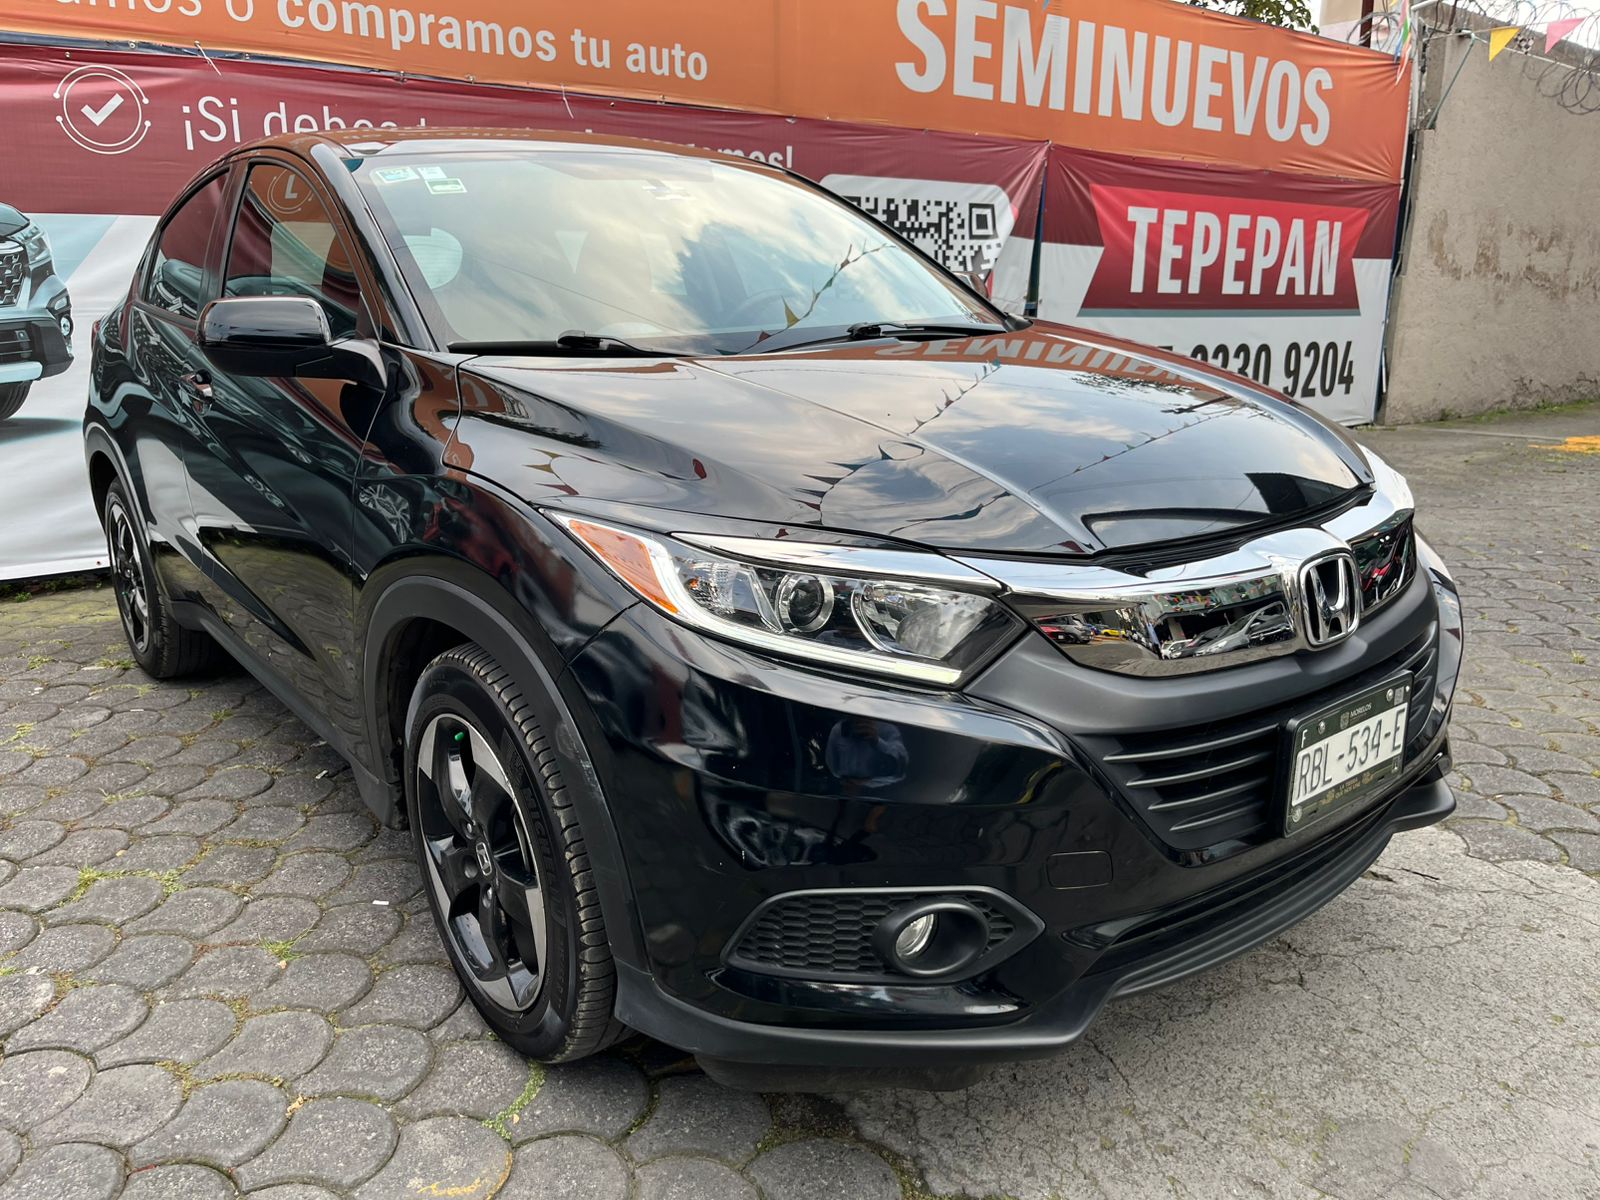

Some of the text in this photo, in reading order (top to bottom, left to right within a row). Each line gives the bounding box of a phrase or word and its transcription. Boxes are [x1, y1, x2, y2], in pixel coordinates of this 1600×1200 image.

[277, 0, 557, 63] compramos
[570, 28, 611, 69] tu
[625, 41, 708, 81] auto
[895, 0, 1334, 146] SEMINUEVOS
[182, 96, 398, 151] ¡Si deb
[1127, 205, 1343, 297] TEPEPAN
[1283, 340, 1354, 398] 9204
